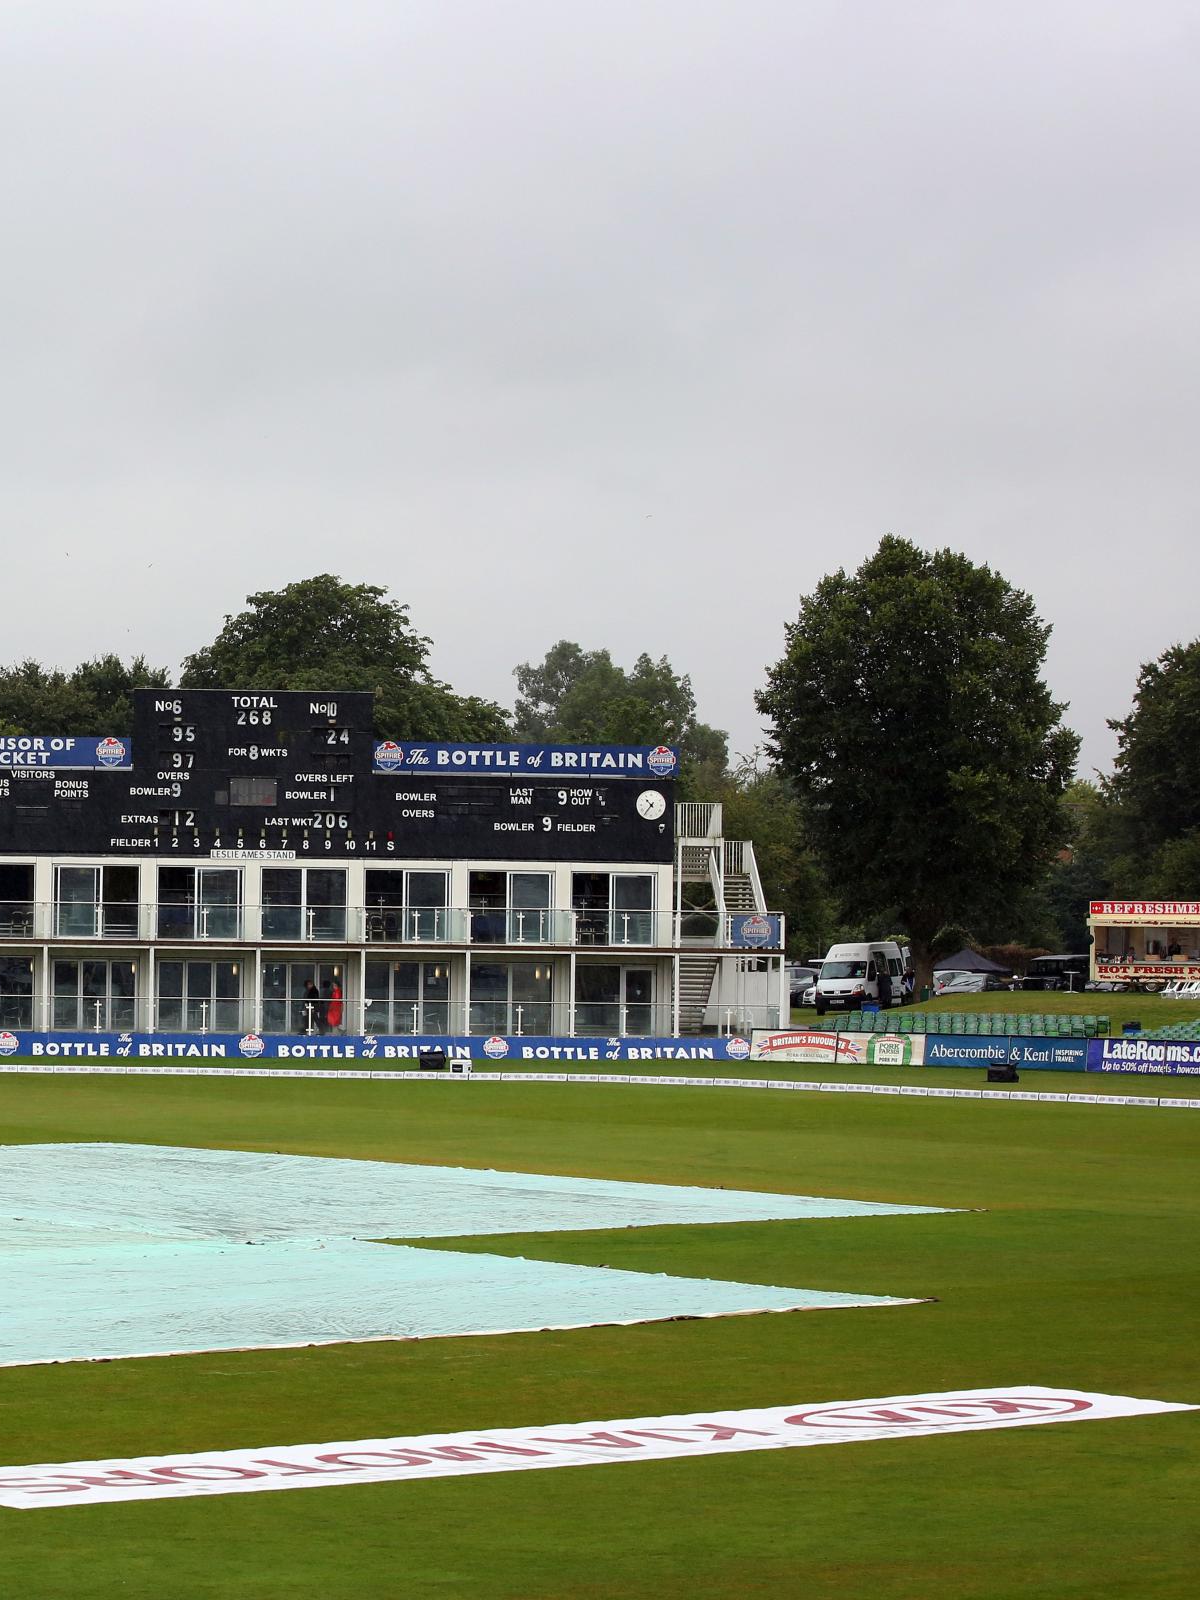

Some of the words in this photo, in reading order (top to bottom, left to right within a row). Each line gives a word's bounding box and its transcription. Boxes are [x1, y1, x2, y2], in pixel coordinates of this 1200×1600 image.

[232, 697, 278, 708] TOTAL
[237, 711, 272, 726] 268
[172, 727, 195, 742] 95
[327, 729, 349, 745] 24
[50, 738, 76, 751] OF
[96, 747, 126, 756] SPITFIRE
[228, 748, 247, 757] FOR
[249, 745, 259, 760] 8
[261, 748, 288, 757] WKTS
[375, 751, 403, 760] SPITFIRE
[172, 753, 194, 769] 97
[406, 749, 430, 765] The
[437, 750, 520, 766] BOTTLE
[527, 750, 545, 767] of
[551, 752, 643, 768] BRITAIN
[647, 756, 676, 765] SPITFIRE
[11, 770, 55, 780] VISITORS
[157, 772, 190, 781] OVERS
[295, 774, 328, 783] OVERS
[330, 774, 354, 783] LEFT
[55, 780, 89, 790] BONUS
[130, 787, 171, 796] BOWLER
[171, 782, 182, 798] 9
[54, 788, 89, 798] POINTS
[285, 791, 327, 800] BOWLER
[395, 792, 437, 802] BOWLER
[509, 788, 534, 797] LAST
[510, 796, 532, 805] MAN
[557, 790, 567, 805] 9
[570, 789, 593, 797] HOW
[571, 797, 591, 805] OUT
[121, 815, 159, 824] EXTRAS
[175, 810, 195, 826] 12
[402, 809, 435, 818] OVERS
[265, 817, 290, 826] LAST
[292, 817, 313, 827] WKT
[313, 813, 348, 829] 206
[493, 822, 535, 831] BOWLER
[542, 817, 552, 832] 9
[557, 823, 596, 832] FIELDER
[110, 838, 151, 847] FIELDER
[153, 838, 159, 848] 1
[171, 838, 179, 848] 2
[193, 838, 200, 848] 3
[213, 838, 221, 848] 4
[236, 839, 244, 849] 5
[259, 839, 266, 849] 6
[281, 839, 288, 849] 7
[302, 840, 310, 850] 8
[324, 840, 332, 850] 9
[345, 840, 356, 850] 10
[365, 840, 377, 850] 11
[386, 841, 395, 851] S
[211, 850, 239, 859] LESLIE
[241, 851, 264, 859] AMES
[267, 851, 294, 859] STAND
[1102, 903, 1200, 914] REFRESHME
[1133, 966, 1185, 974] FRESH
[117, 1033, 132, 1043] The
[363, 1035, 377, 1044] The
[607, 1038, 621, 1047] The
[772, 1035, 806, 1047] BRITAIN'S
[808, 1036, 846, 1049] FAVOURTE
[32, 1042, 110, 1056] BOTTLE
[116, 1043, 131, 1058] of
[139, 1043, 226, 1057] BRITAIN
[278, 1044, 355, 1058] BOTTLE
[362, 1044, 377, 1059] of
[522, 1046, 599, 1060] BOTTLE
[606, 1047, 620, 1061] of
[627, 1047, 714, 1060] BRITAIN
[930, 1044, 1005, 1059] Abercrombie
[1010, 1048, 1021, 1061] &
[1024, 1048, 1049, 1062] Kent
[1055, 1049, 1084, 1057] INSPIRING
[1055, 1055, 1075, 1063] TRAVEL
[1102, 1060, 1112, 1071] Up
[1112, 1061, 1120, 1071] to
[1121, 1062, 1137, 1072] 50%
[1137, 1063, 1148, 1073] off
[542, 1423, 777, 1448] KIA
